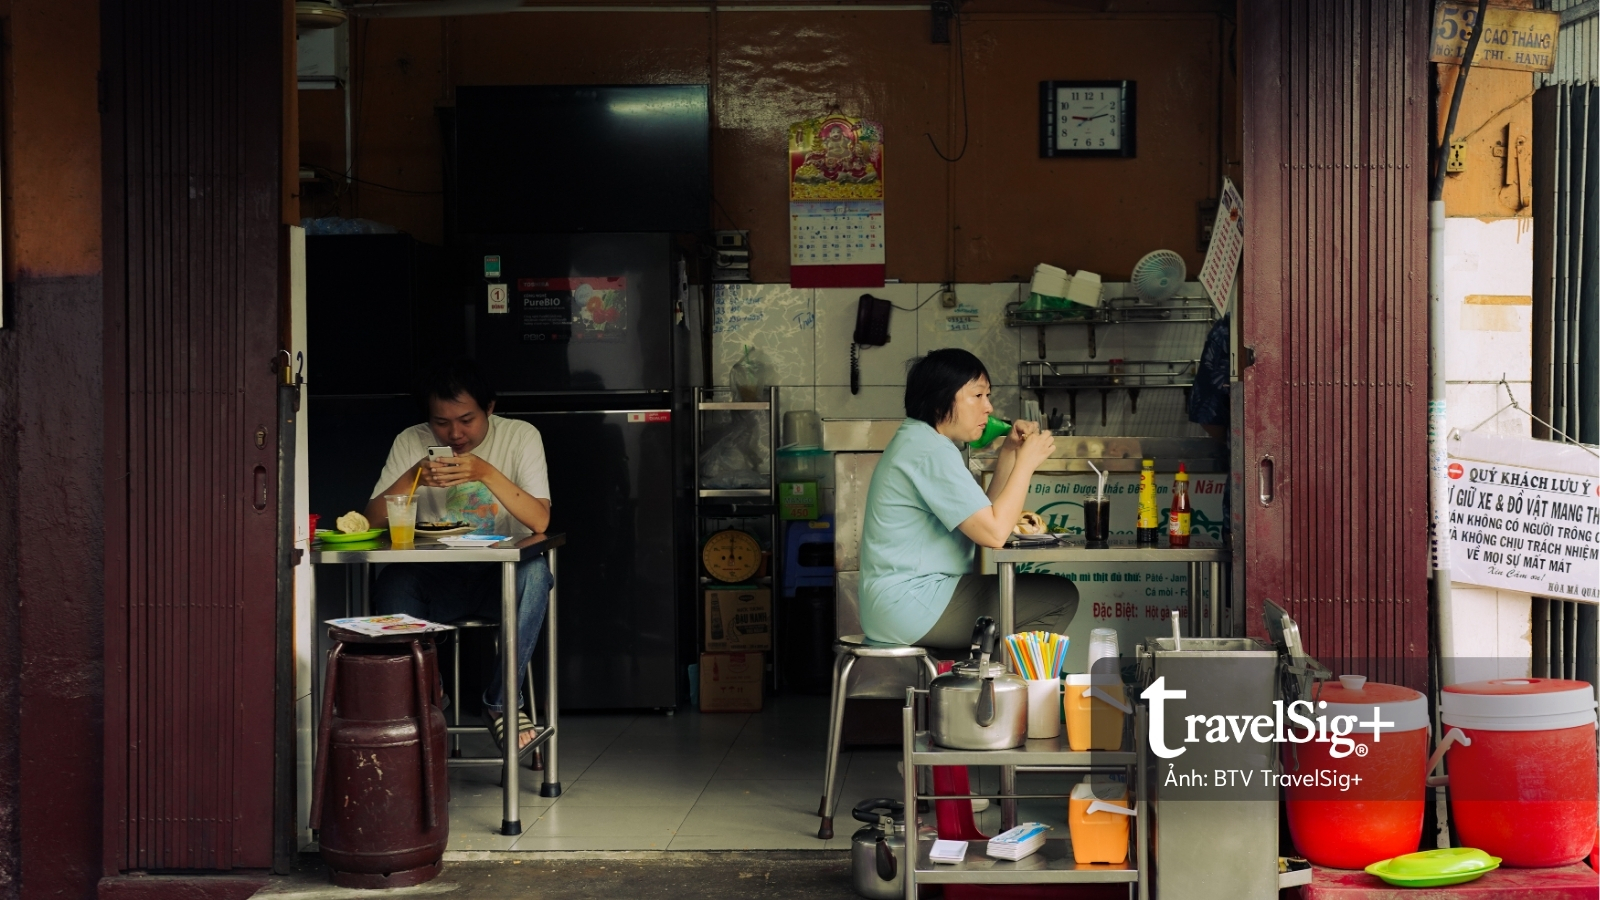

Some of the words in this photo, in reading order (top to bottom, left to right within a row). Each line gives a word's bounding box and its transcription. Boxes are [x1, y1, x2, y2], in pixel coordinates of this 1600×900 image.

[1439, 7, 1478, 42] 53
[1484, 28, 1508, 45] CAO
[1512, 25, 1551, 49] THẮNG
[1071, 92, 1079, 100] 11
[1084, 92, 1094, 100] 12
[1100, 92, 1104, 100] 1
[1061, 102, 1069, 110] 10
[1109, 101, 1116, 110] 2
[1061, 115, 1067, 124] 9
[1109, 115, 1116, 123] 3
[1061, 129, 1068, 137] 8
[1072, 138, 1078, 146] 7
[1085, 138, 1091, 146] 6
[1099, 138, 1105, 146] 5
[524, 298, 561, 306] PureBIO
[1470, 467, 1497, 482] QUÝ
[1501, 471, 1548, 489] KHÁCH
[1551, 478, 1578, 493] LƯU
[1582, 479, 1591, 494] Ý
[1035, 483, 1050, 495] Địa
[1054, 483, 1070, 494] Chỉ
[1073, 483, 1097, 495] Được
[1195, 480, 1226, 494] Năm
[1456, 486, 1477, 508] GIỮ
[1477, 492, 1493, 510] XE
[1495, 494, 1504, 512] &
[1507, 489, 1524, 514] ĐỒ
[1527, 494, 1548, 520] VẬT
[1551, 501, 1583, 522] MANG
[791, 509, 809, 517] 450
[1449, 510, 1464, 524] ÁN
[1467, 514, 1502, 530] KHÔNG
[1506, 518, 1519, 532] CÓ
[1523, 522, 1554, 537] NGƯỜI
[1558, 526, 1592, 542] TRÔNG
[1461, 530, 1497, 546] KHÔNG
[1500, 536, 1524, 551] CHỊU
[1527, 539, 1562, 555] TRÁCH
[1565, 544, 1599, 560] NHIỆM
[1467, 545, 1481, 561] VỀ
[1483, 551, 1503, 565] MỌI
[1506, 553, 1521, 568] SỰ
[1523, 554, 1546, 569] MẤT
[1549, 559, 1572, 573] MÁT
[1488, 566, 1503, 575] Xin
[1079, 572, 1091, 582] mì
[1093, 572, 1108, 583] thịt
[1111, 572, 1122, 582] đủ
[1124, 572, 1141, 582] thứ:
[1145, 573, 1163, 582] Pâté
[1170, 573, 1187, 582] Jam
[1145, 587, 1156, 596] Cá
[1158, 587, 1173, 596] mòi
[1093, 602, 1112, 621] Đặc
[1115, 602, 1138, 621] Biệt:
[1145, 605, 1158, 620] Hột
[1160, 605, 1170, 621] gà
